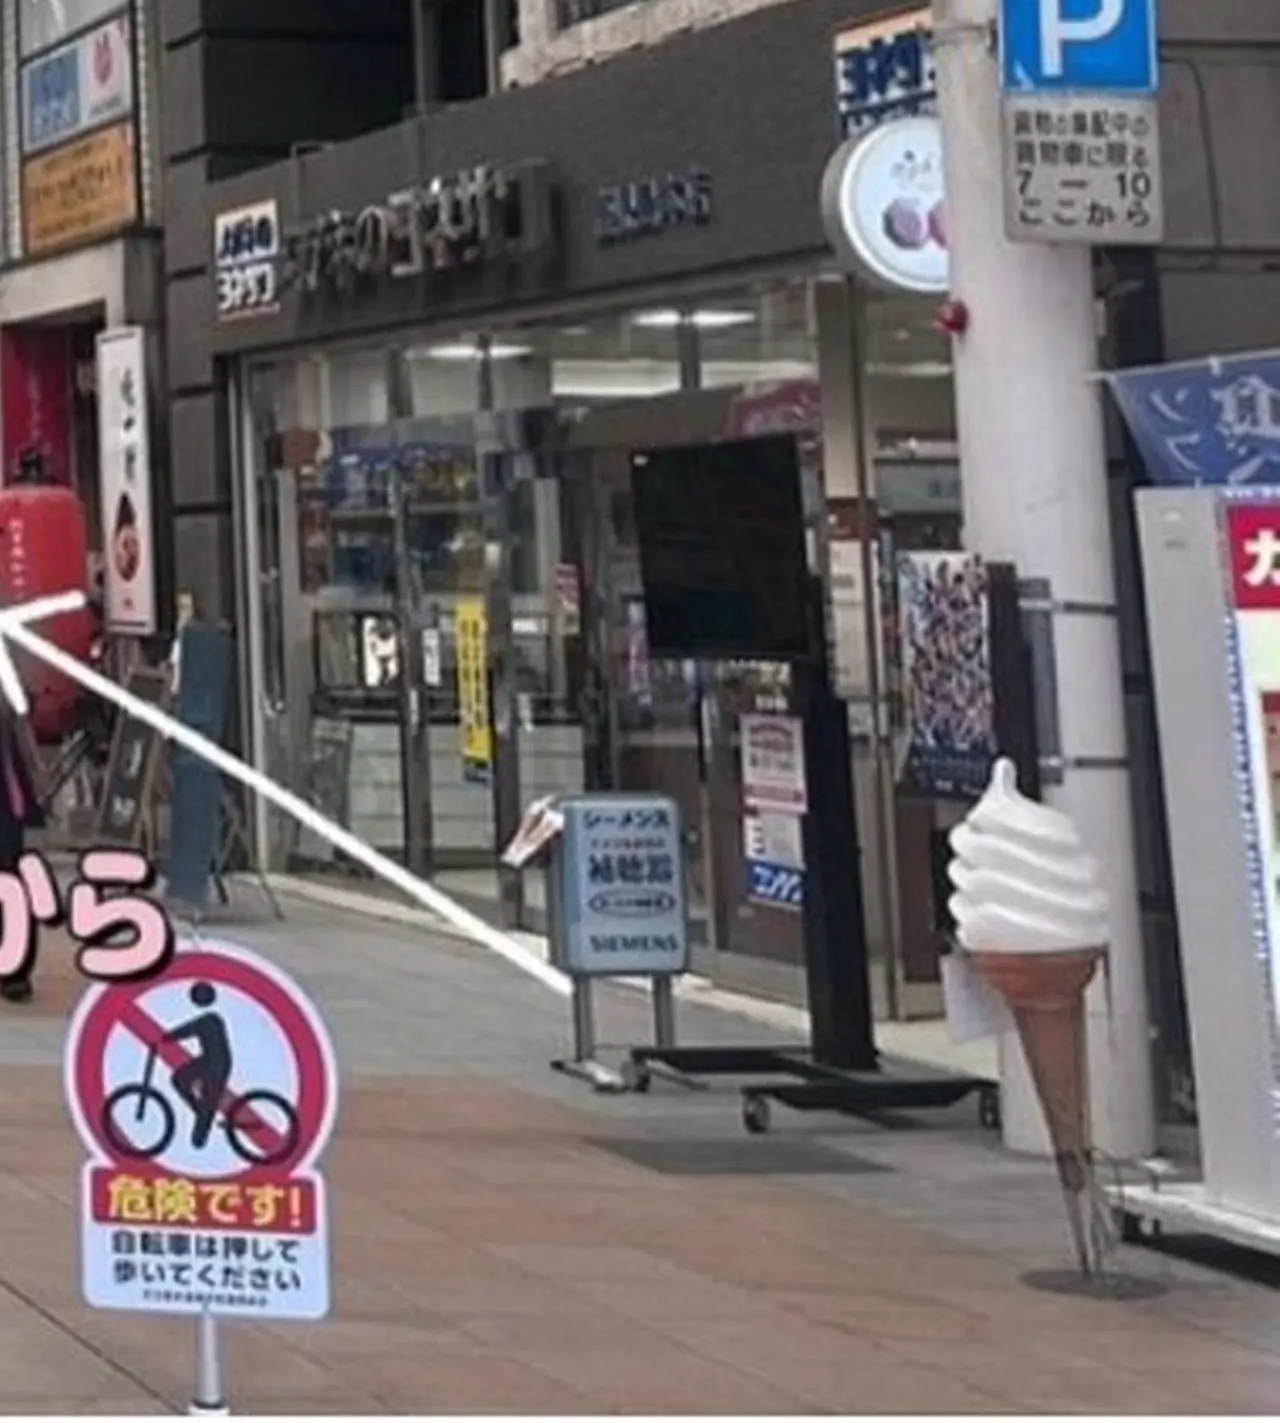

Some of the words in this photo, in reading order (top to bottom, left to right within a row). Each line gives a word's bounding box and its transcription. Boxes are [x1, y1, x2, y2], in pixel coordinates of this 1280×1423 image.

[1015, 169, 1033, 196] 7
[1117, 172, 1152, 198] 10
[1017, 198, 1151, 228] ここから
[584, 808, 670, 829] シーメンス
[591, 933, 679, 954] SIEMENS
[107, 1173, 303, 1228] 危険です!
[112, 1230, 301, 1263] 自転車は押して
[112, 1259, 302, 1291] 歩いてください
